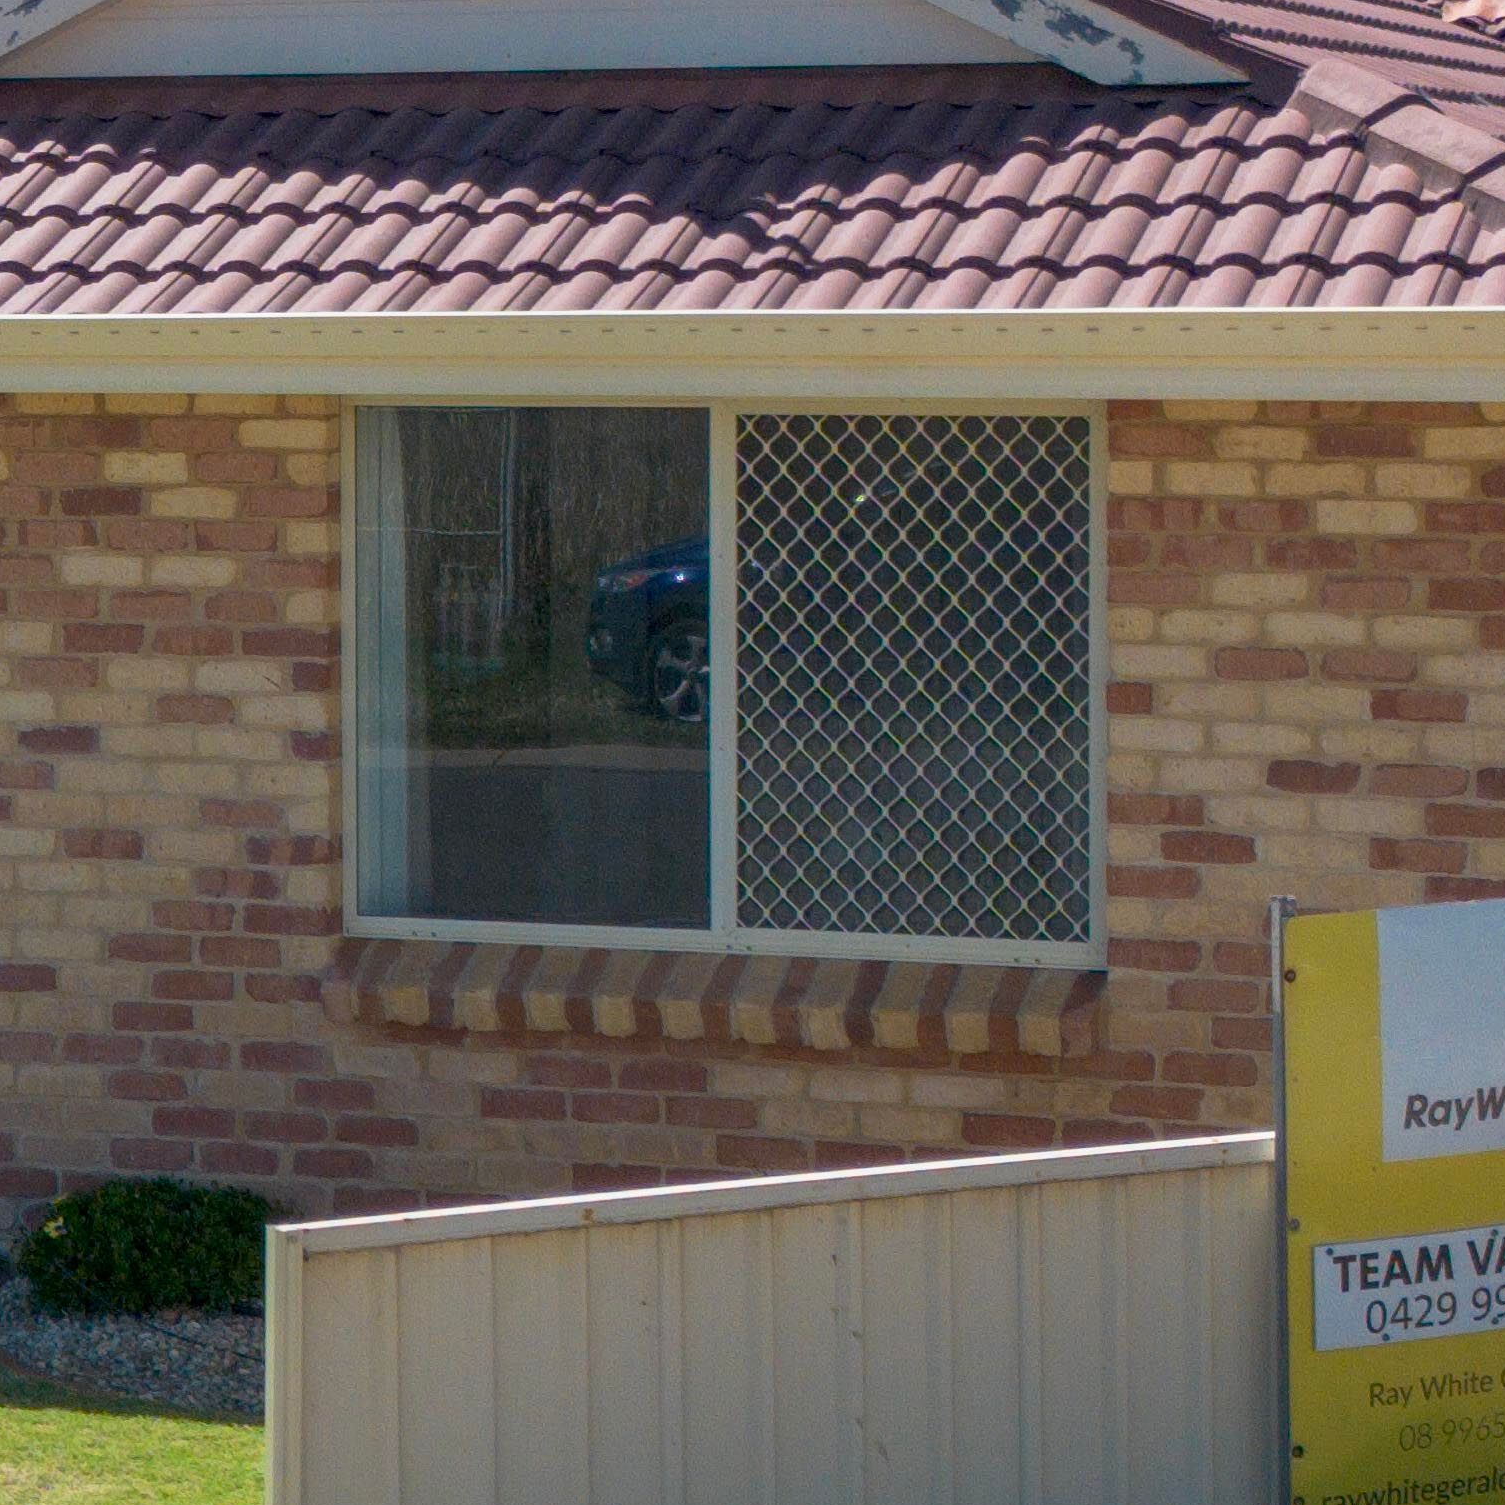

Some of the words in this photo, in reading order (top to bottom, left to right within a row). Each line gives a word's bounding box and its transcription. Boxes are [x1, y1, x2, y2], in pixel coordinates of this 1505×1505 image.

[1333, 1244, 1454, 1293] TEAM
[1366, 1292, 1457, 1334] 0429
[1369, 1382, 1413, 1408] Ray
[1420, 1371, 1493, 1401] White
[1399, 1422, 1432, 1452] 08
[1442, 1411, 1505, 1446] 9965
